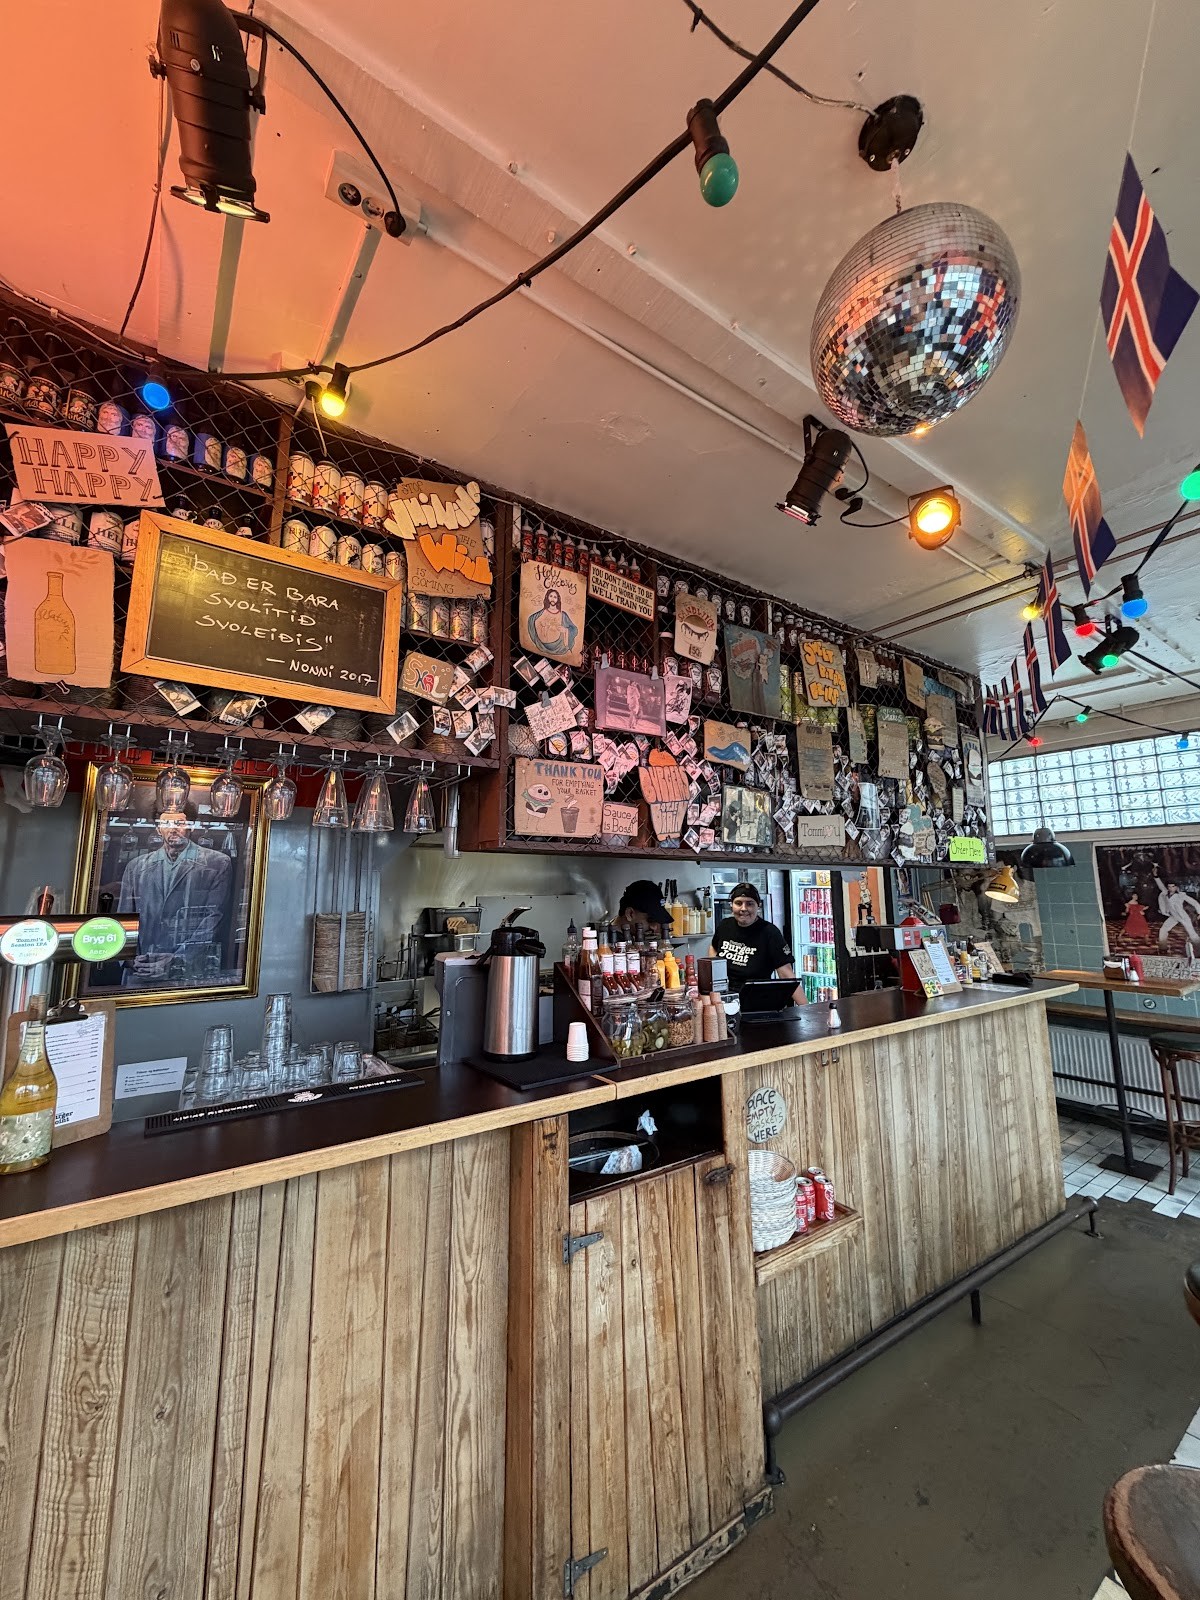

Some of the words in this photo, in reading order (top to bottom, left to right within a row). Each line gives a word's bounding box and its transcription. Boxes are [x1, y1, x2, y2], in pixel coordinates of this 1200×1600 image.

[16, 437, 147, 475] HAPPY
[32, 468, 154, 501] HAPPY
[534, 564, 561, 581] Holy
[411, 575, 454, 594] COMING
[591, 576, 609, 589] CRAZY
[610, 584, 618, 593] TO
[618, 587, 634, 599] WORK
[592, 567, 604, 579] YOU
[604, 572, 621, 585] DON'T
[622, 580, 637, 593] HAVE
[638, 586, 645, 596] TO
[645, 590, 654, 600] BE
[246, 577, 276, 596] ER
[286, 587, 339, 611] BARA
[592, 585, 613, 600] WE'LL
[615, 595, 638, 610] TRAIN
[638, 604, 653, 616] YOU
[340, 669, 378, 686] 2017
[534, 762, 577, 777] THANK
[581, 766, 602, 780] YOU
[556, 787, 571, 795] YOUR
[565, 779, 595, 788] EMPTYING
[604, 805, 632, 819] Sauce
[604, 821, 611, 832] is
[951, 839, 968, 854] Order
[969, 841, 981, 857] Here
[82, 934, 105, 945] Bryg
[106, 934, 117, 942] 61
[721, 941, 757, 955] Burger
[719, 950, 749, 963] Joint
[55, 1110, 74, 1120] urger
[55, 1117, 70, 1125] oint
[747, 1104, 777, 1125] EMPTY
[753, 1125, 779, 1141] HERE
